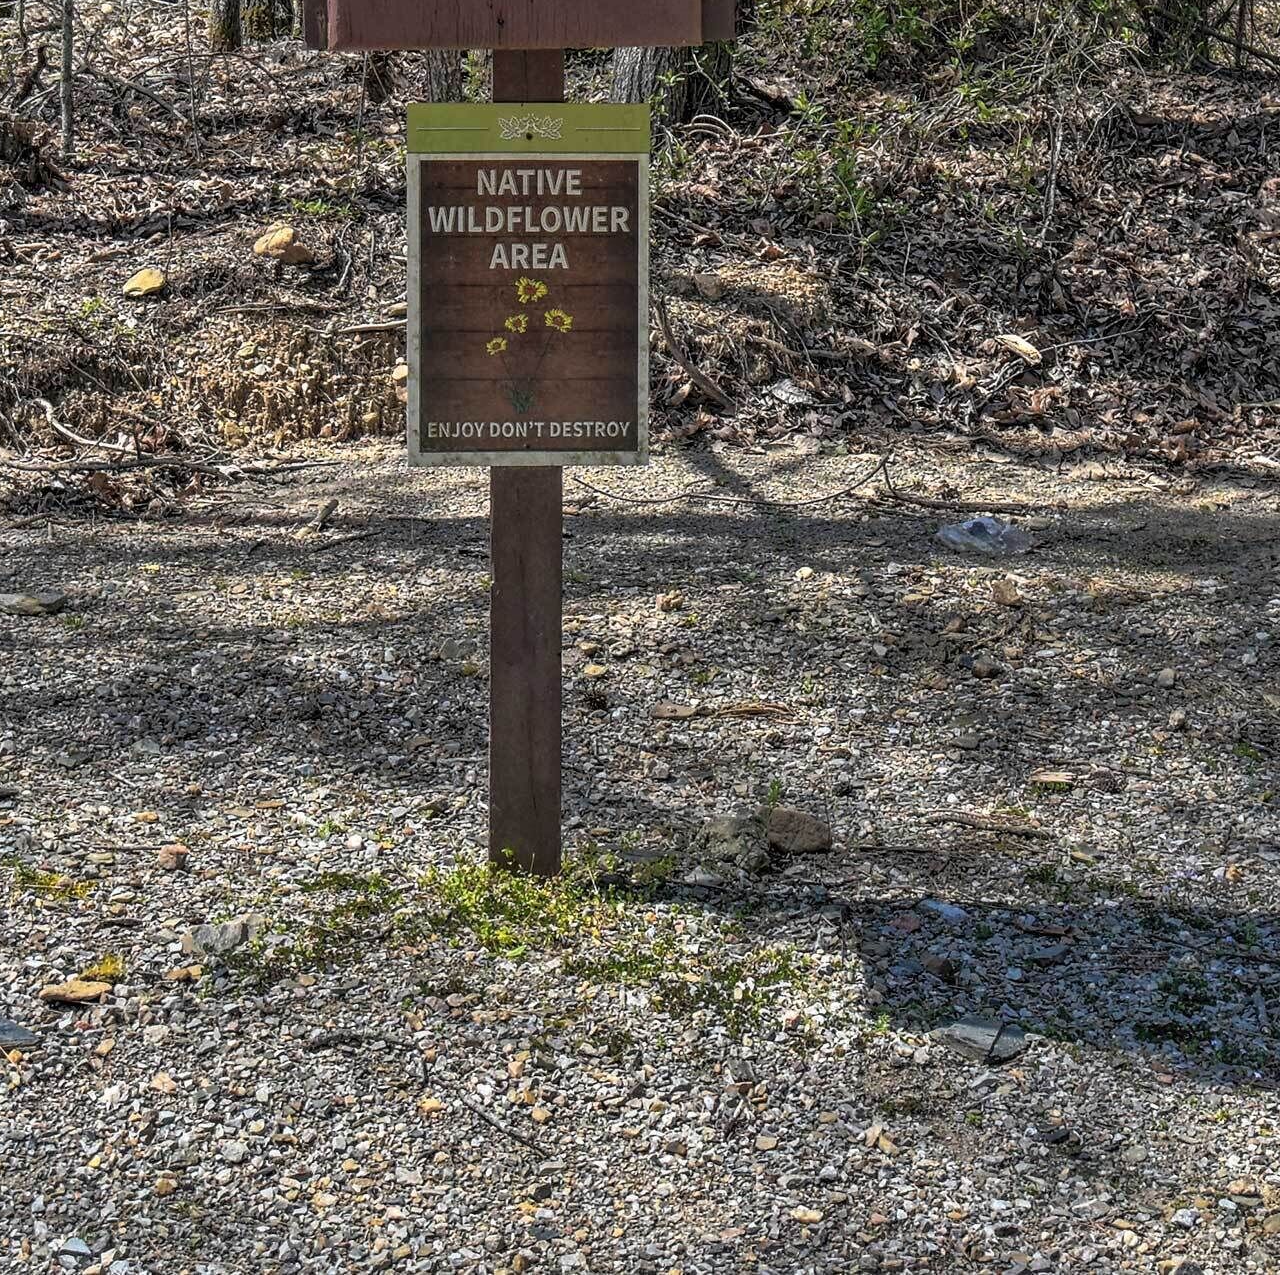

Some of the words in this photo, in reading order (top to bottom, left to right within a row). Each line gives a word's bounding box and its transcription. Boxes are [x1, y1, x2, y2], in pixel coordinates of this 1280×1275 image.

[476, 168, 582, 196] NATIVE
[428, 205, 631, 233] WILDFLOWER
[489, 243, 569, 270] AREA
[427, 421, 485, 439] ENJOY
[489, 421, 545, 438] DON'T
[549, 421, 631, 438] DESTROY
